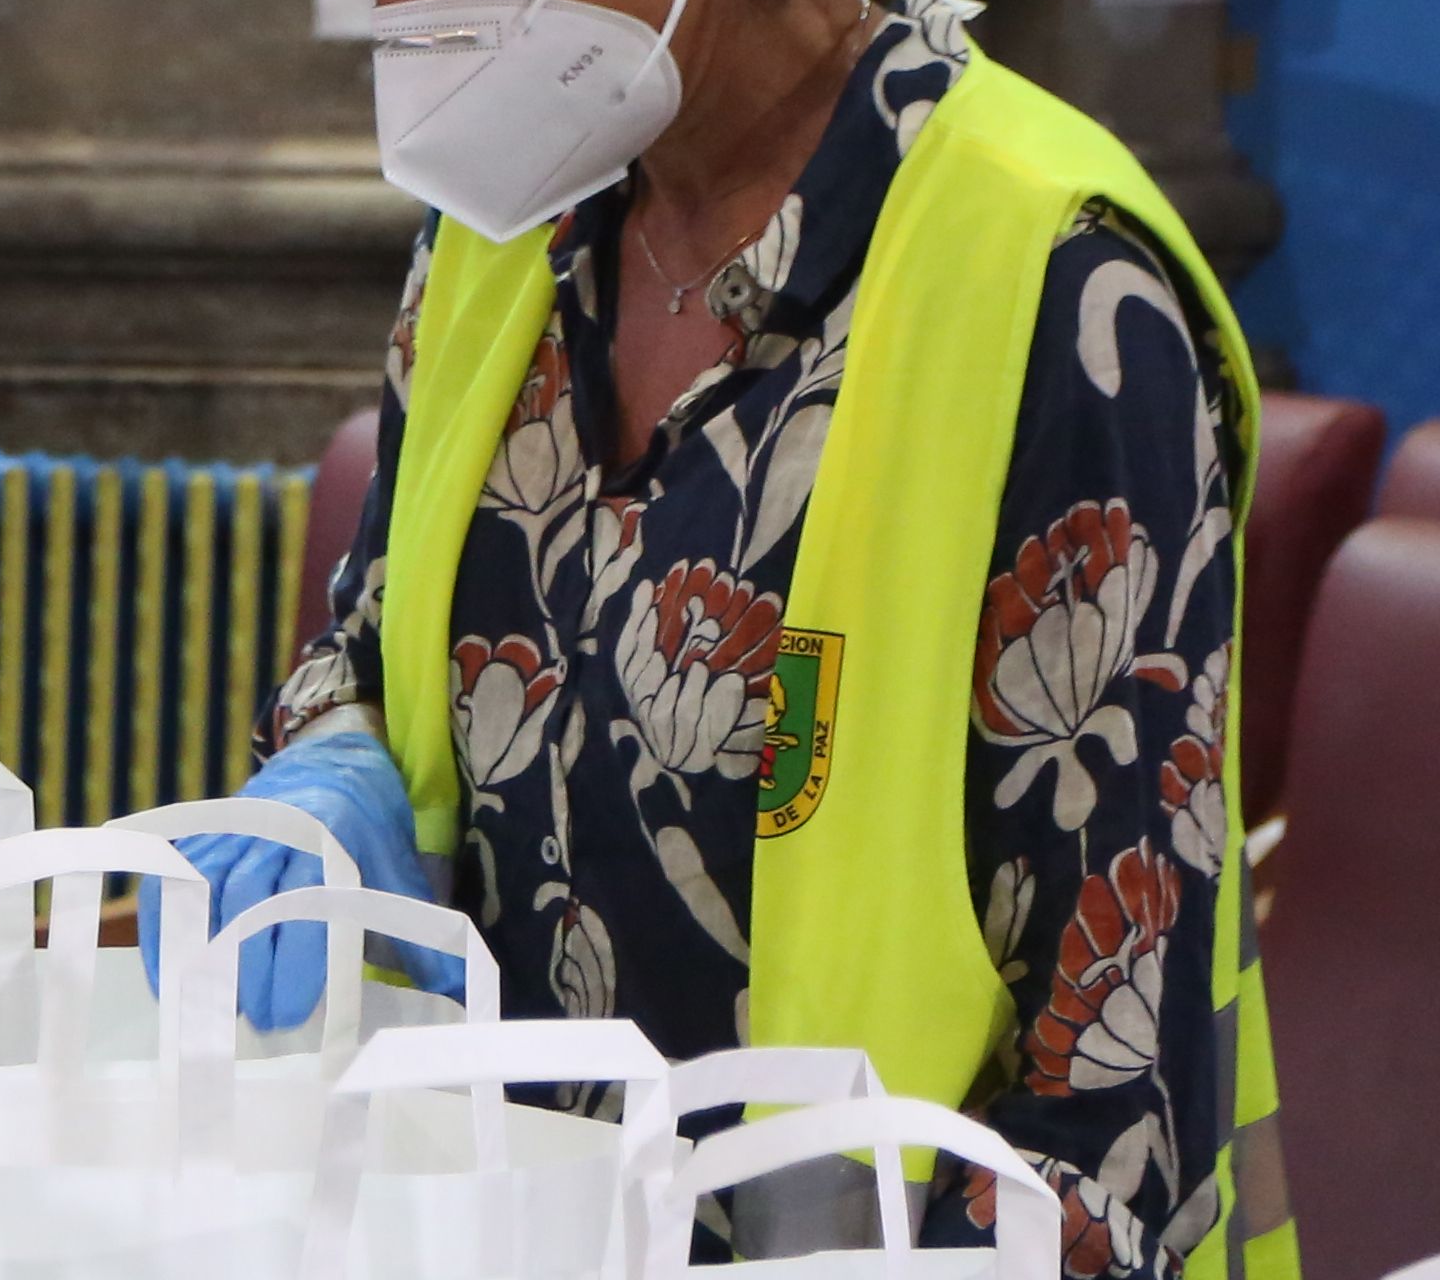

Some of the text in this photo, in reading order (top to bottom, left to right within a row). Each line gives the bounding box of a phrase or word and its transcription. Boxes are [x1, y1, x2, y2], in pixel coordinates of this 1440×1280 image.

[557, 44, 604, 88] KN95
[772, 720, 829, 829] DE LA PAZ
